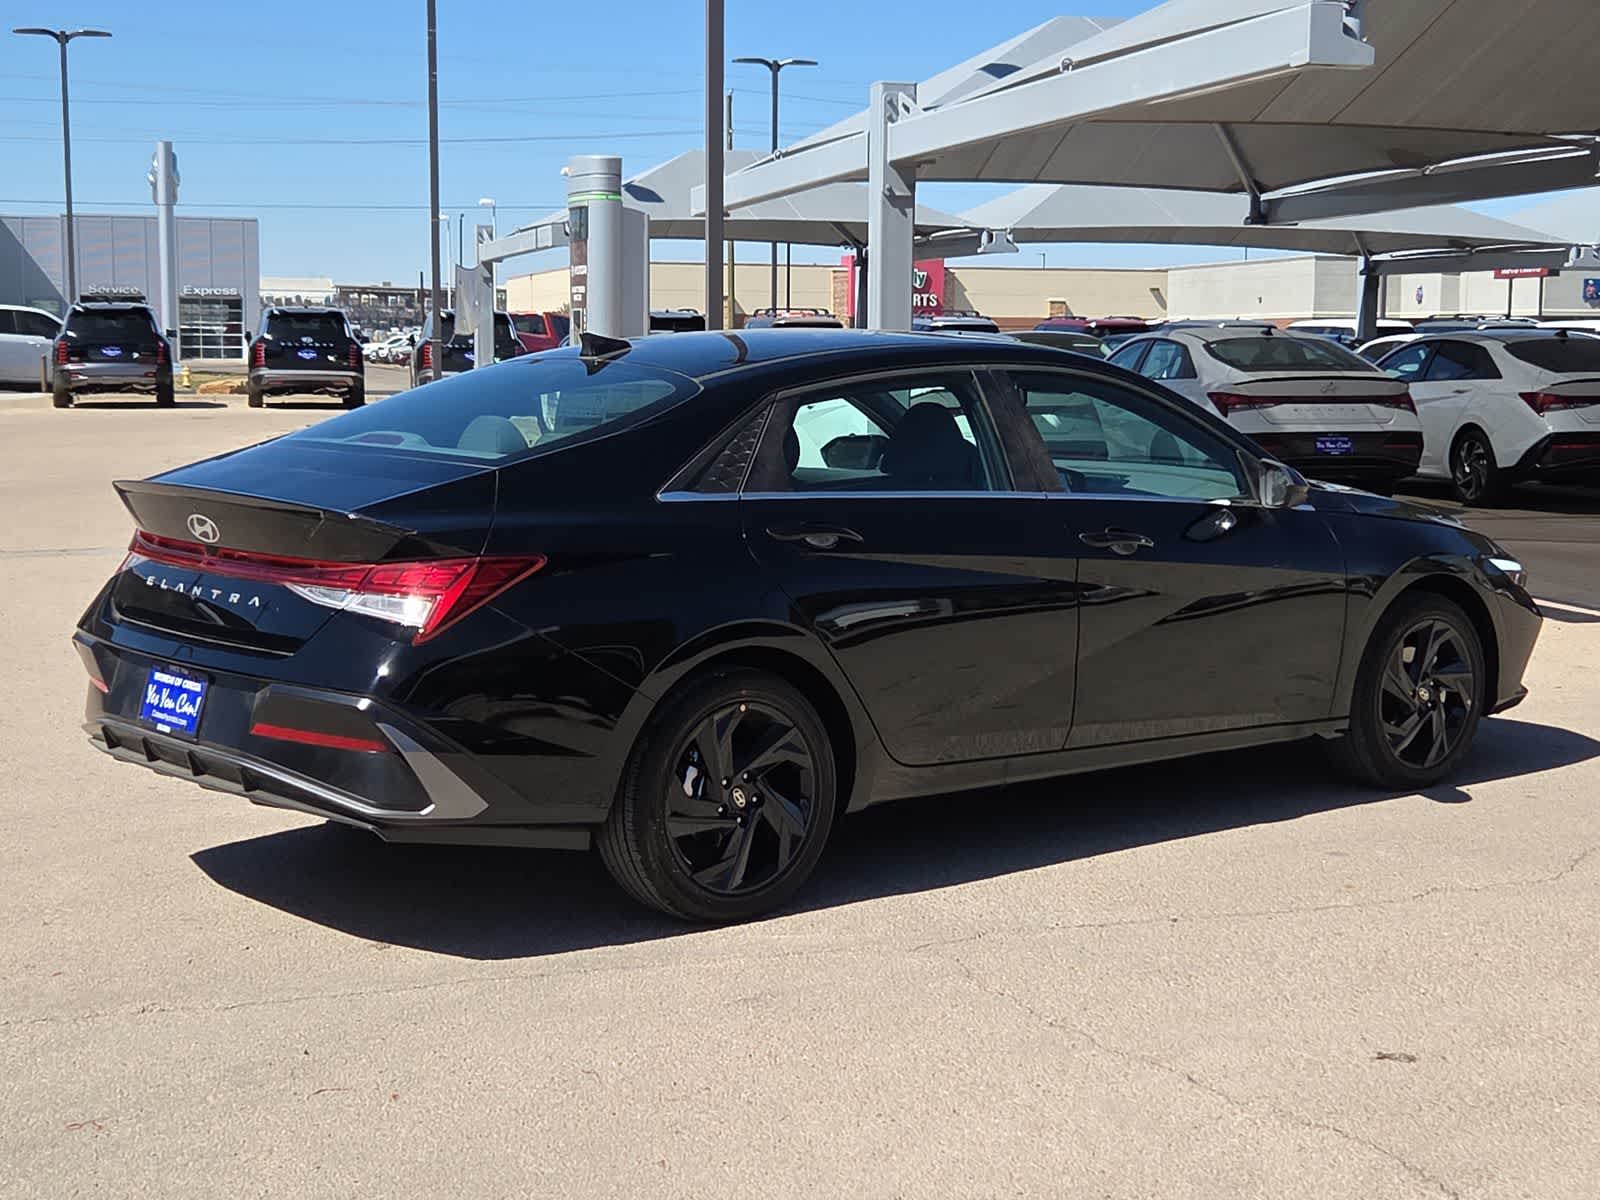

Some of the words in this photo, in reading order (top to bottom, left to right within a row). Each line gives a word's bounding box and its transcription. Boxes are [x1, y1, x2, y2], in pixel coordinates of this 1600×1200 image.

[183, 285, 238, 297] Express
[913, 293, 938, 307] RTS
[146, 575, 260, 607] ELANTRA
[145, 683, 160, 706] Yes
[159, 688, 175, 709] You
[175, 693, 202, 717] Can!
